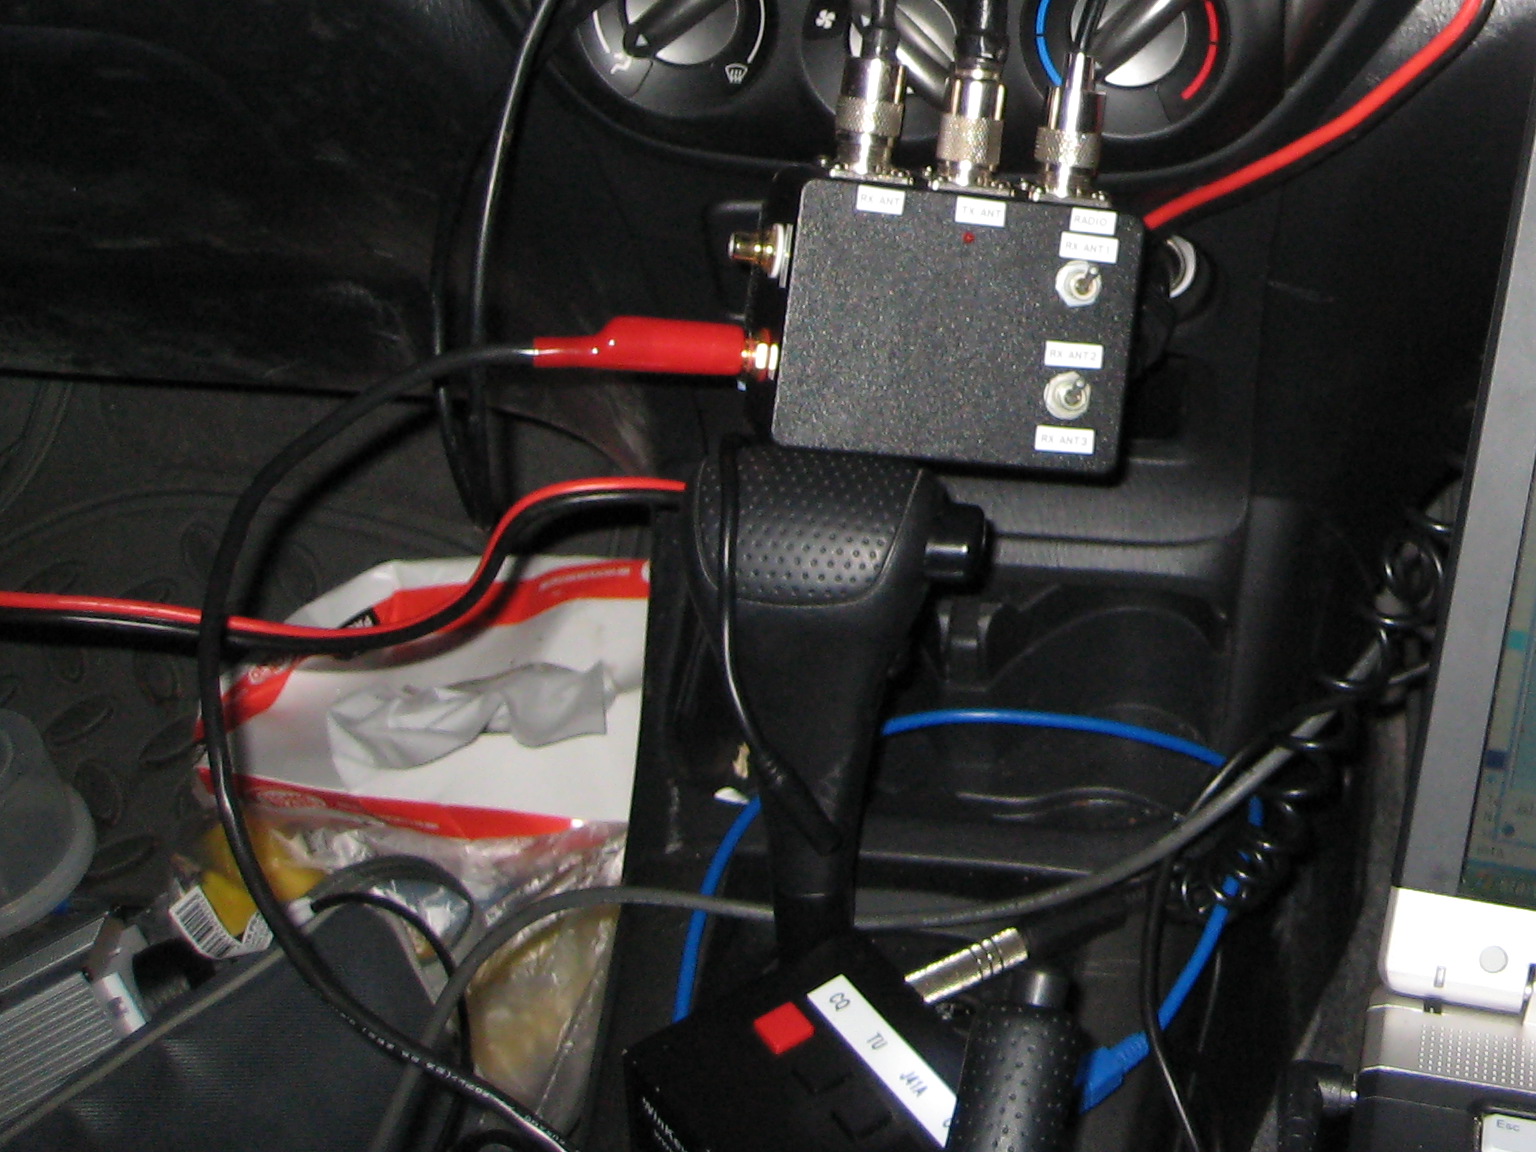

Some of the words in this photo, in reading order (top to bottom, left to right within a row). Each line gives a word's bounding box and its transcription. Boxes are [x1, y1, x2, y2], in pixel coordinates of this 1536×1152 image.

[879, 195, 902, 207] ANT
[980, 208, 1002, 220] ANT
[1073, 214, 1108, 227] RADIO
[866, 1032, 888, 1050] TU
[1496, 1119, 1520, 1132] Esc
